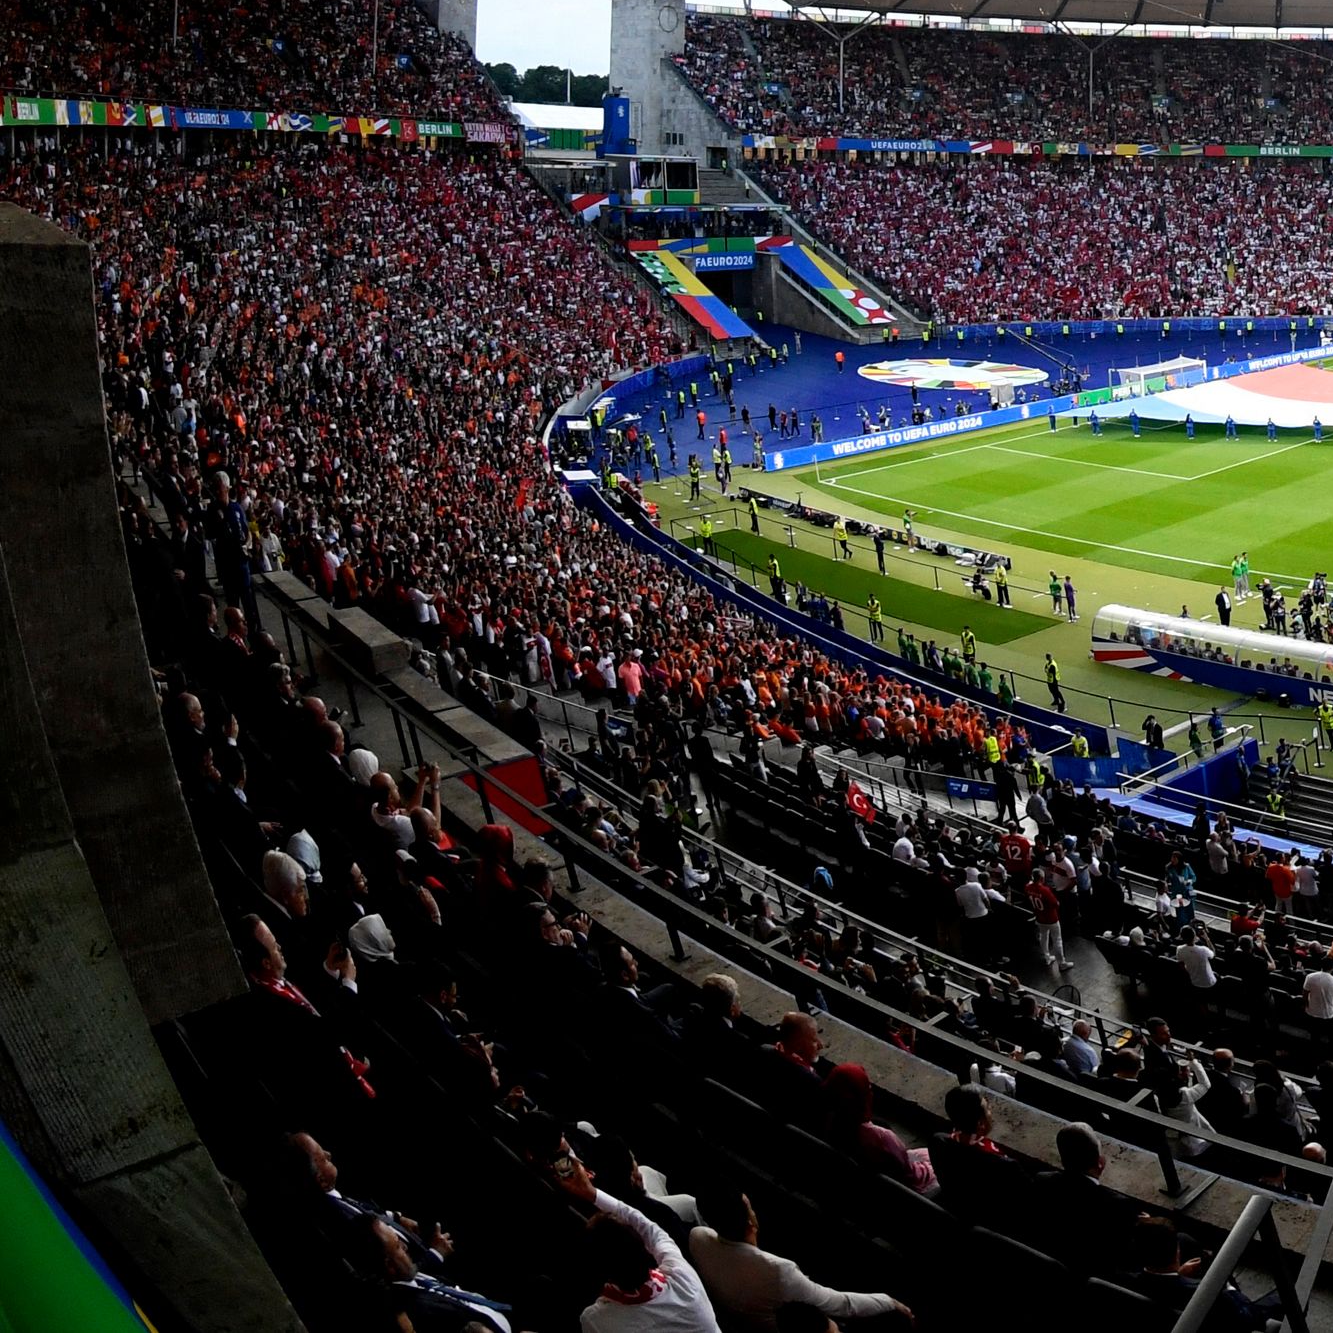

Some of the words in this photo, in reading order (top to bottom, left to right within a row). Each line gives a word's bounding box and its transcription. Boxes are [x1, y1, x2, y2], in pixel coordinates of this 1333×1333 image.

[418, 123, 452, 135] BERLIN
[1260, 147, 1300, 155] BERLIN
[695, 256, 753, 267] FAEURO2024
[832, 436, 887, 455] WELCOME
[887, 432, 902, 444] TO
[903, 427, 929, 441] UEFA
[930, 421, 957, 436] EURO
[957, 416, 983, 429] 2024
[1006, 845, 1022, 860] 12
[1029, 896, 1044, 911] 10
